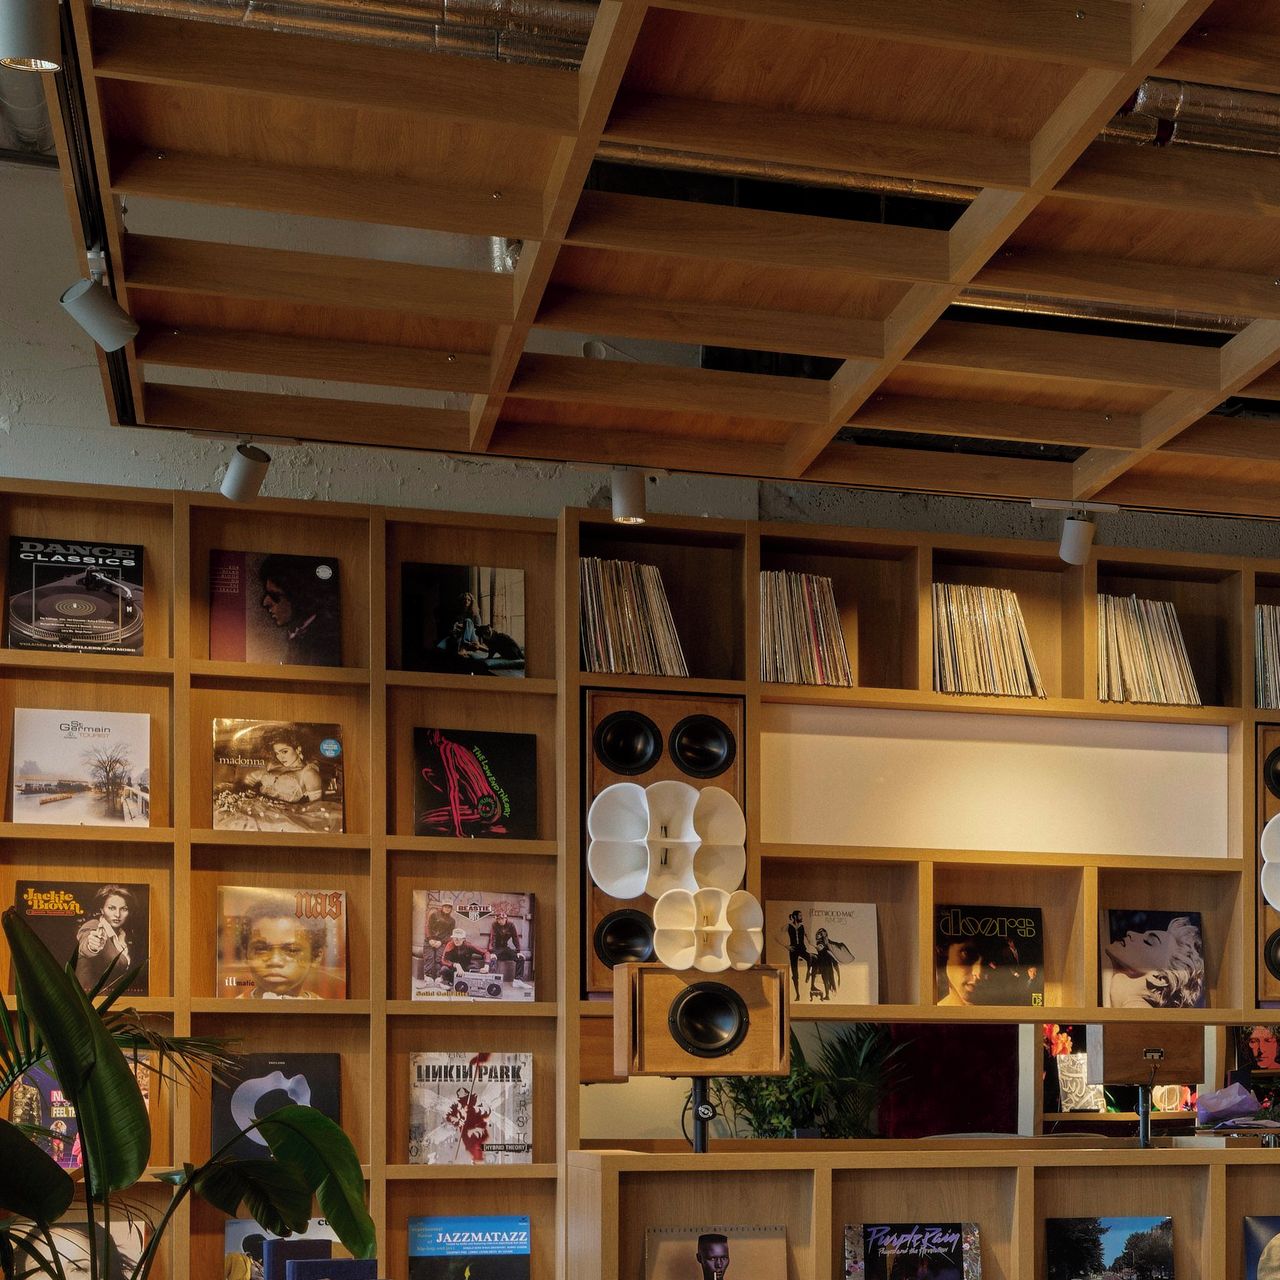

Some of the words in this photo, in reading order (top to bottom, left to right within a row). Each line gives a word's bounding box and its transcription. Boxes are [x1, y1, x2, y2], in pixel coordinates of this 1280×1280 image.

[20, 541, 135, 559] DANCE
[20, 553, 136, 566] CLASSICS
[60, 723, 111, 733] Germain
[220, 755, 265, 767] madonna
[472, 745, 486, 761] THE
[481, 760, 494, 777] LOW
[488, 776, 500, 791] END
[24, 888, 74, 901] Jackie
[28, 900, 84, 915] Brown
[294, 891, 342, 920] nas
[940, 908, 1036, 938] doors
[416, 1064, 473, 1082] LINKIN
[478, 1064, 522, 1082] PARK
[52, 1109, 66, 1118] FEEL
[436, 1231, 528, 1243] JAZZMATAZZ
[867, 1225, 923, 1254] Purple
[922, 1227, 961, 1253] Rain
